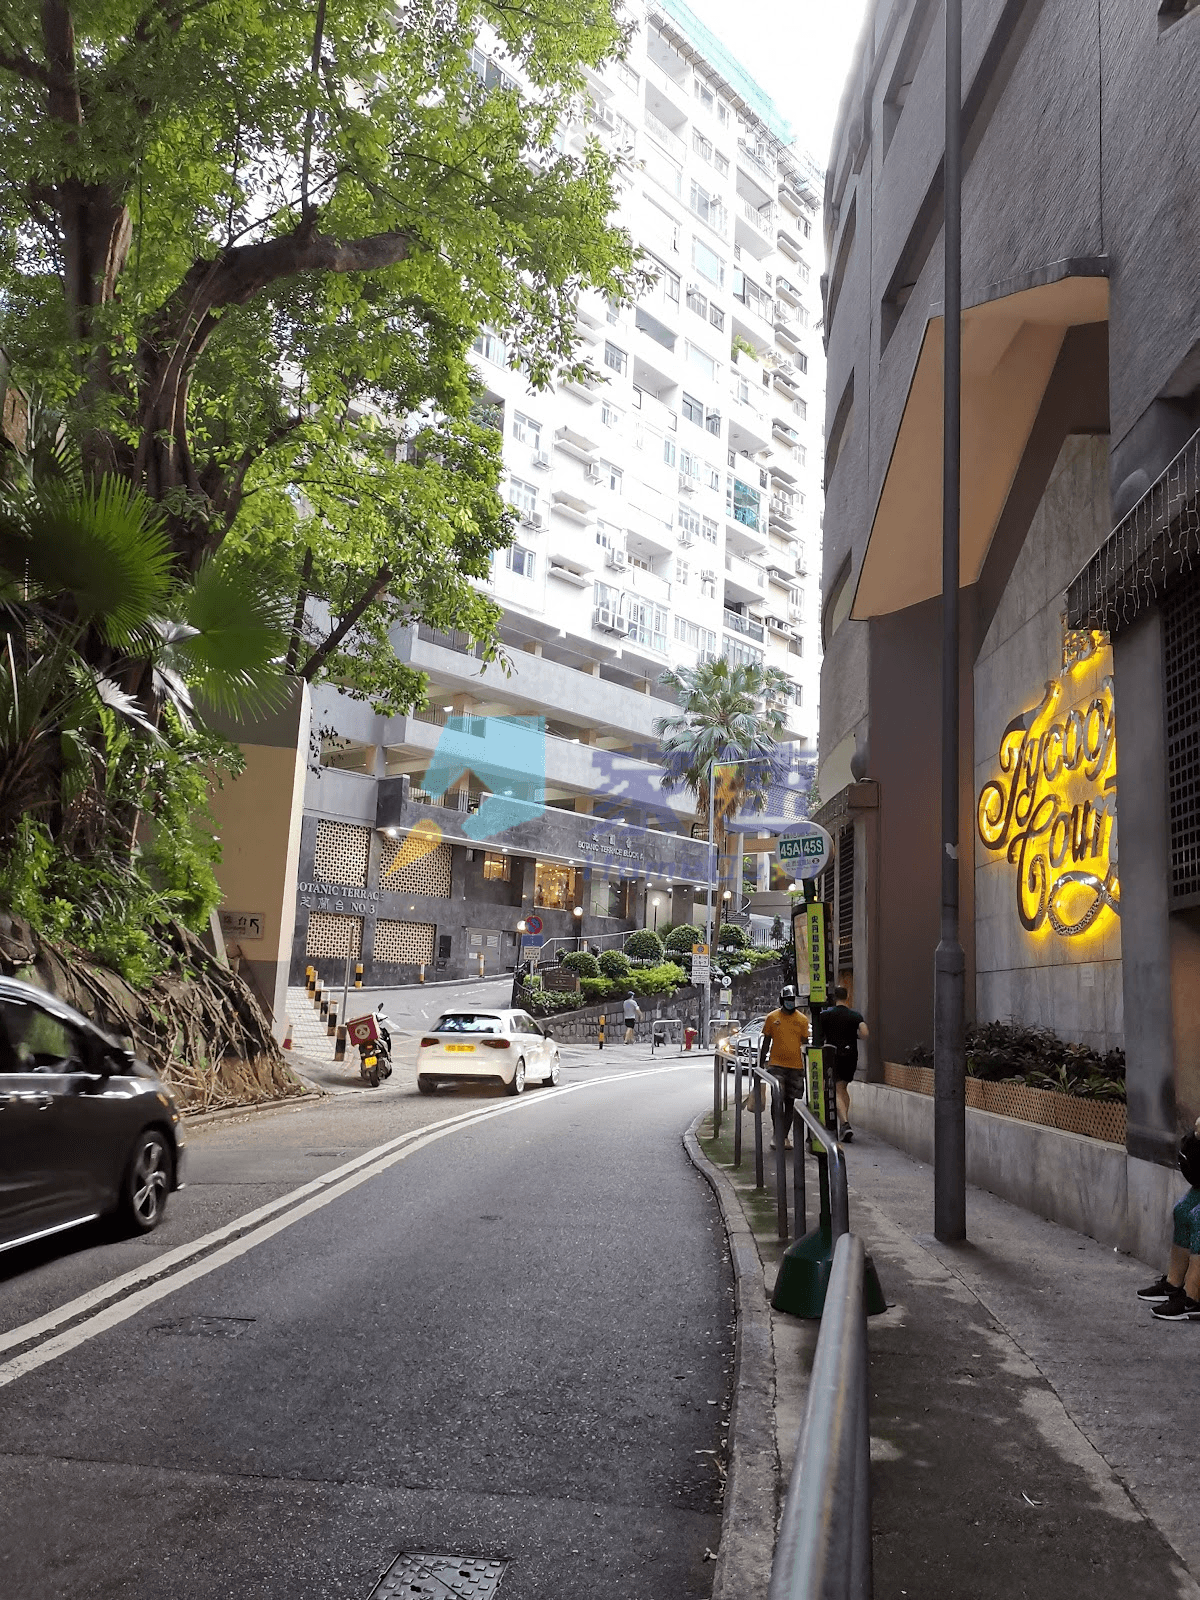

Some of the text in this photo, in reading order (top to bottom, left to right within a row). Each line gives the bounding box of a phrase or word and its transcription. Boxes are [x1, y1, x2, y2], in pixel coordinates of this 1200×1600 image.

[577, 840, 600, 852] BOTANIC
[601, 845, 623, 857] TERRACE
[780, 839, 823, 857] 45A 45S
[341, 886, 385, 901] TERRACE
[369, 904, 375, 914] 3
